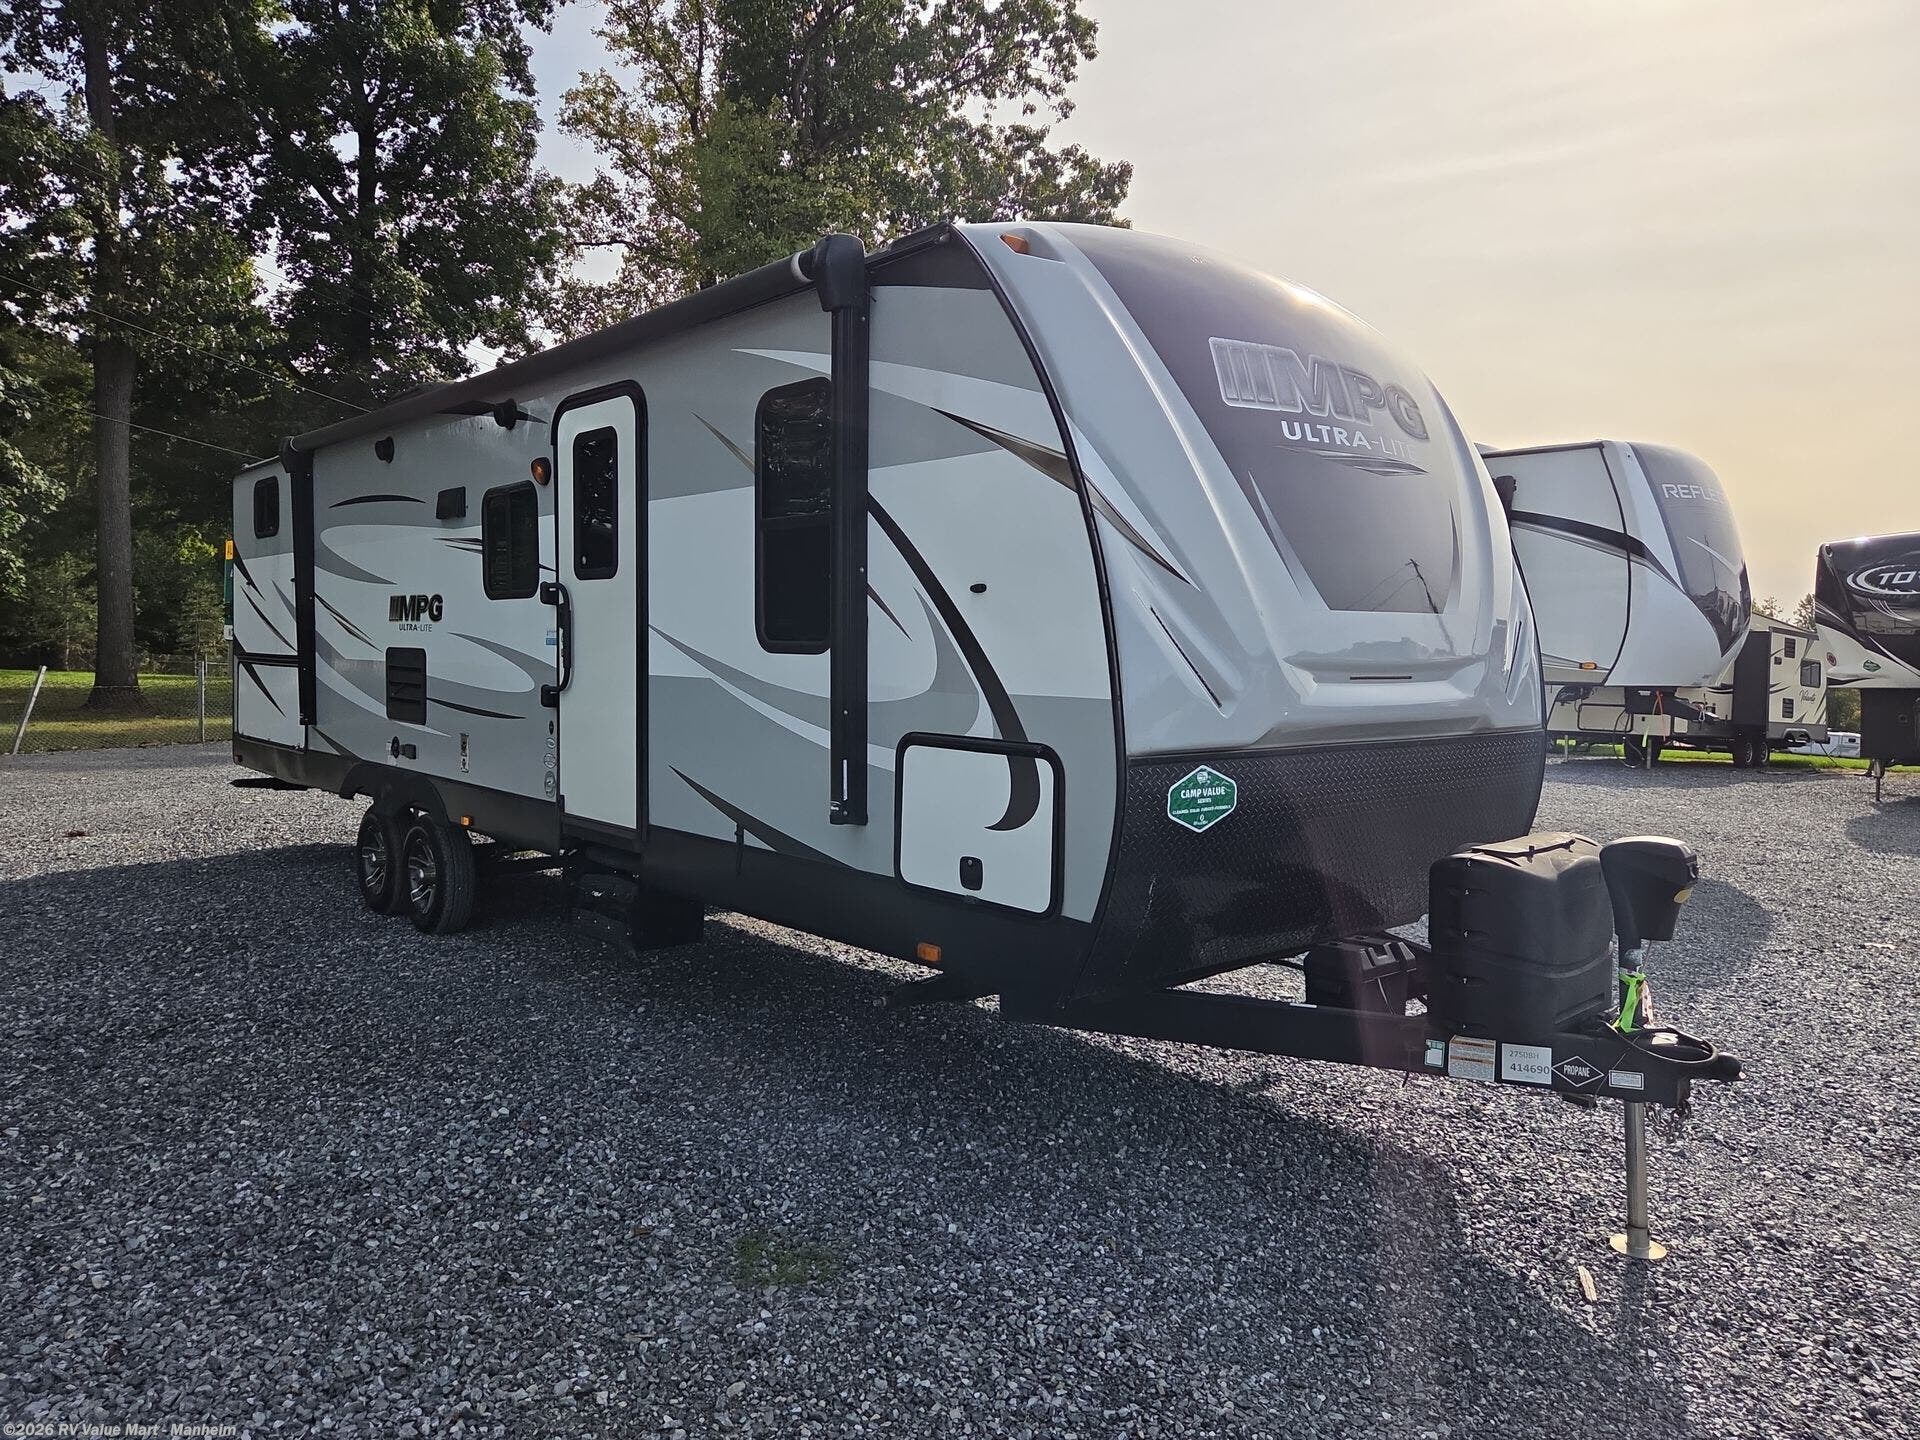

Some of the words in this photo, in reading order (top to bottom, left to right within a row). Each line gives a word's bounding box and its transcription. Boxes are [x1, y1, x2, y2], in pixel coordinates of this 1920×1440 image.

[1264, 344, 1429, 440] MPG
[1879, 571, 1920, 585] TO
[400, 594, 443, 622] MPG
[399, 623, 432, 632] ULTRA-LITE
[1181, 789, 1201, 798] CAMP
[1203, 787, 1225, 796] VALUE
[1510, 1063, 1550, 1074] 414690
[1563, 1064, 1590, 1077] PROPANE
